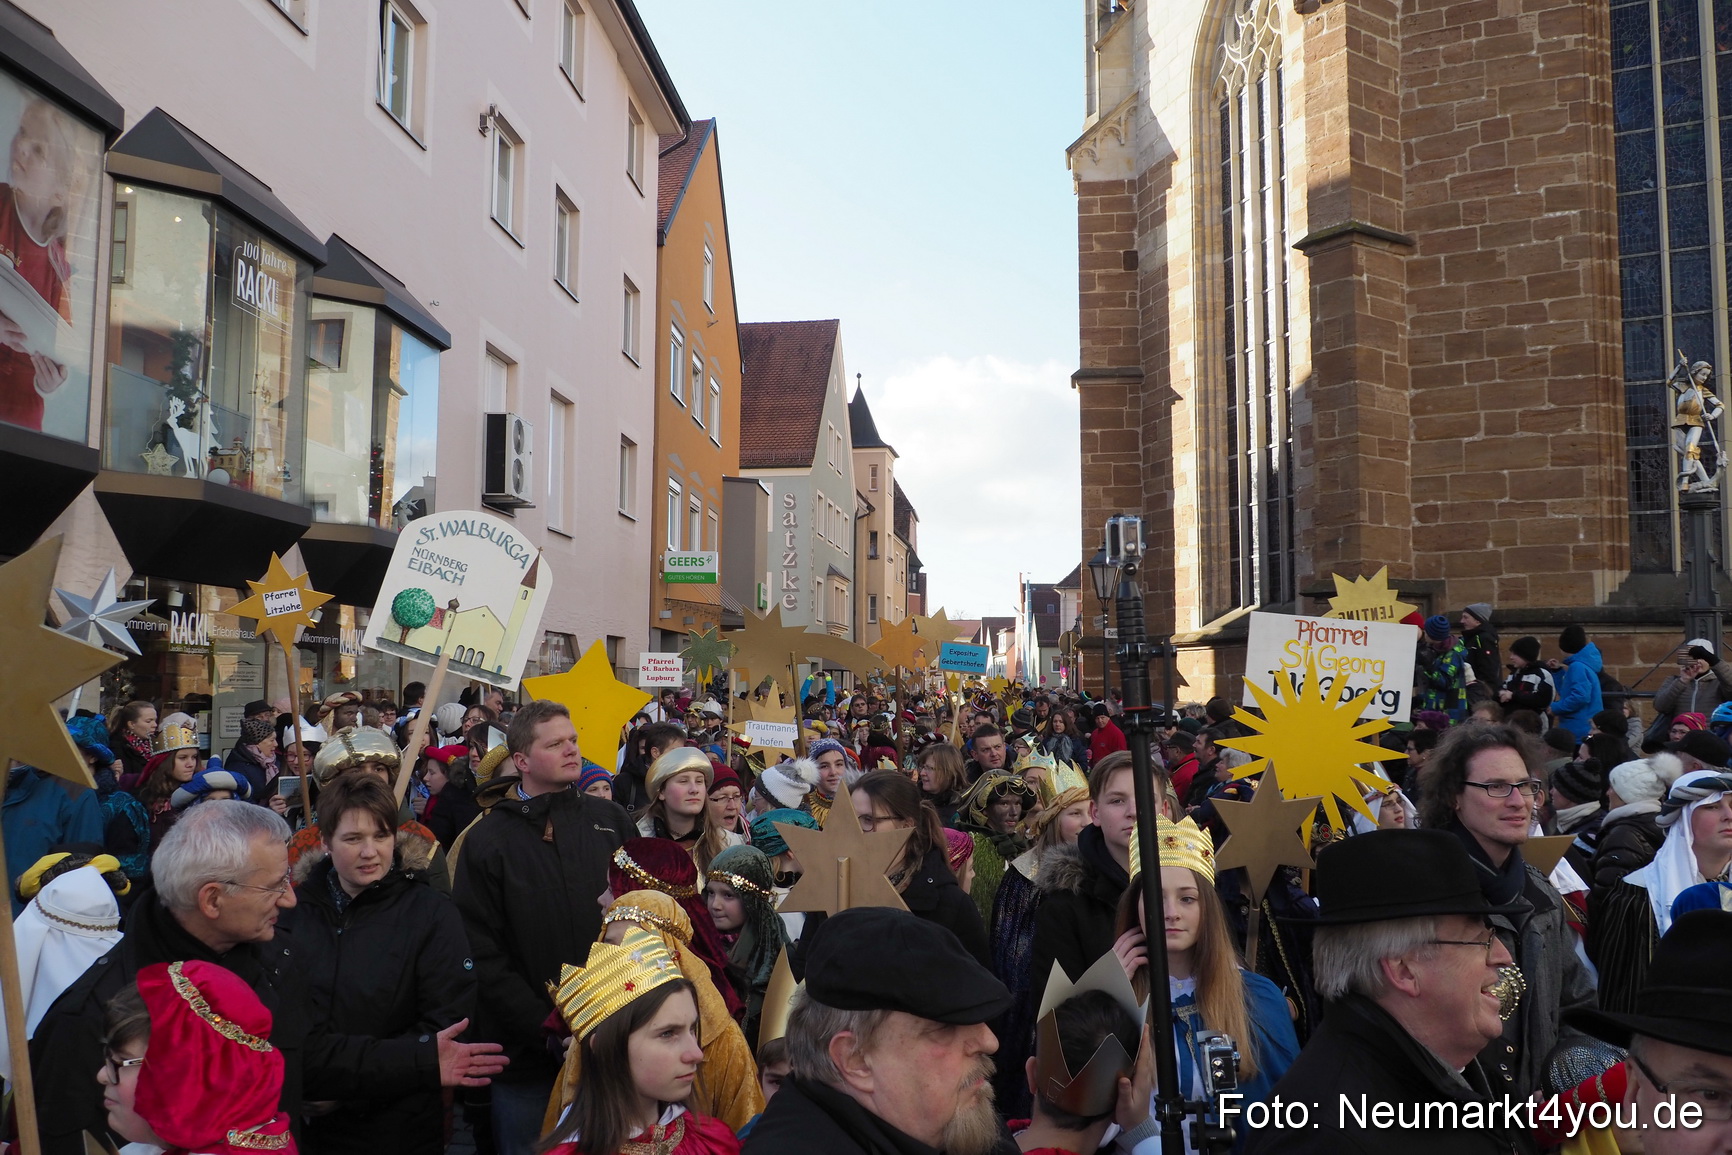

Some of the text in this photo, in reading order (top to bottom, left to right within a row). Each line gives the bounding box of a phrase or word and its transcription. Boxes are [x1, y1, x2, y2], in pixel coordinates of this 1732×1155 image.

[242, 241, 287, 273] 100 Jahre
[236, 258, 277, 317] RACKL
[439, 519, 530, 570] WALBURGA
[781, 492, 798, 610] satzke
[407, 557, 466, 586] EIBACH
[411, 546, 468, 573] NÜRNBERG
[668, 556, 705, 567] GEERS
[685, 573, 705, 581] HÖREN
[264, 588, 297, 602] Pfarrei
[265, 602, 302, 616] Litzlohe
[158, 620, 168, 632] im
[170, 610, 210, 646] RACKL
[212, 625, 257, 639] Erlebnishaus.
[1294, 619, 1369, 647] Pfarrei
[941, 658, 985, 668] Gebertshofen
[948, 648, 979, 657] Expositur
[1317, 644, 1386, 684] Georg
[760, 737, 784, 747] hofen
